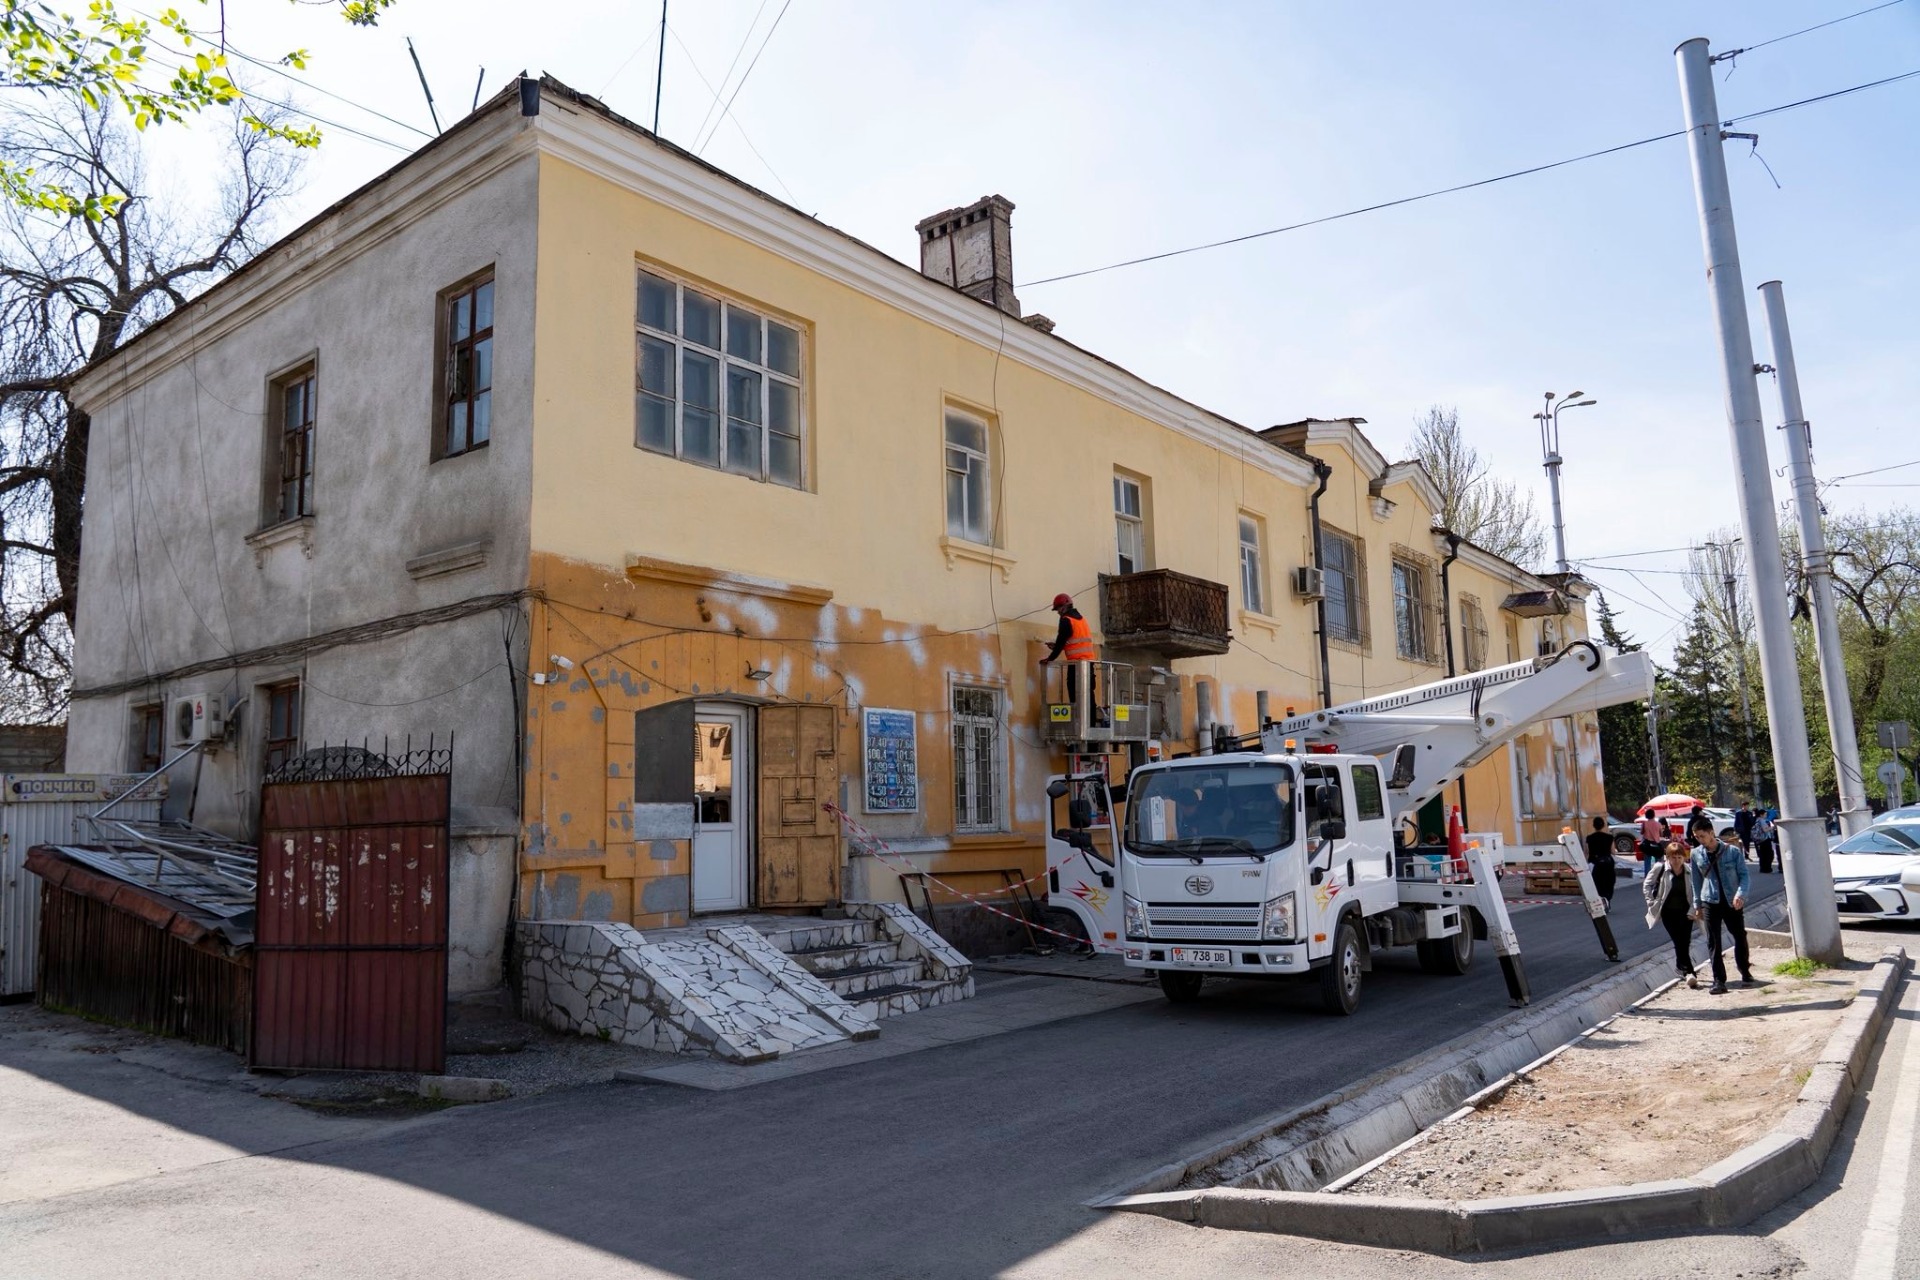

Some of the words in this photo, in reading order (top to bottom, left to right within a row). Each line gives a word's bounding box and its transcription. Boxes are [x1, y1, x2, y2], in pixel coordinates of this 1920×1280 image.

[21, 780, 95, 794] ПОНЧИКИ
[1193, 951, 1211, 961] 738
[1214, 953, 1225, 962] DB
